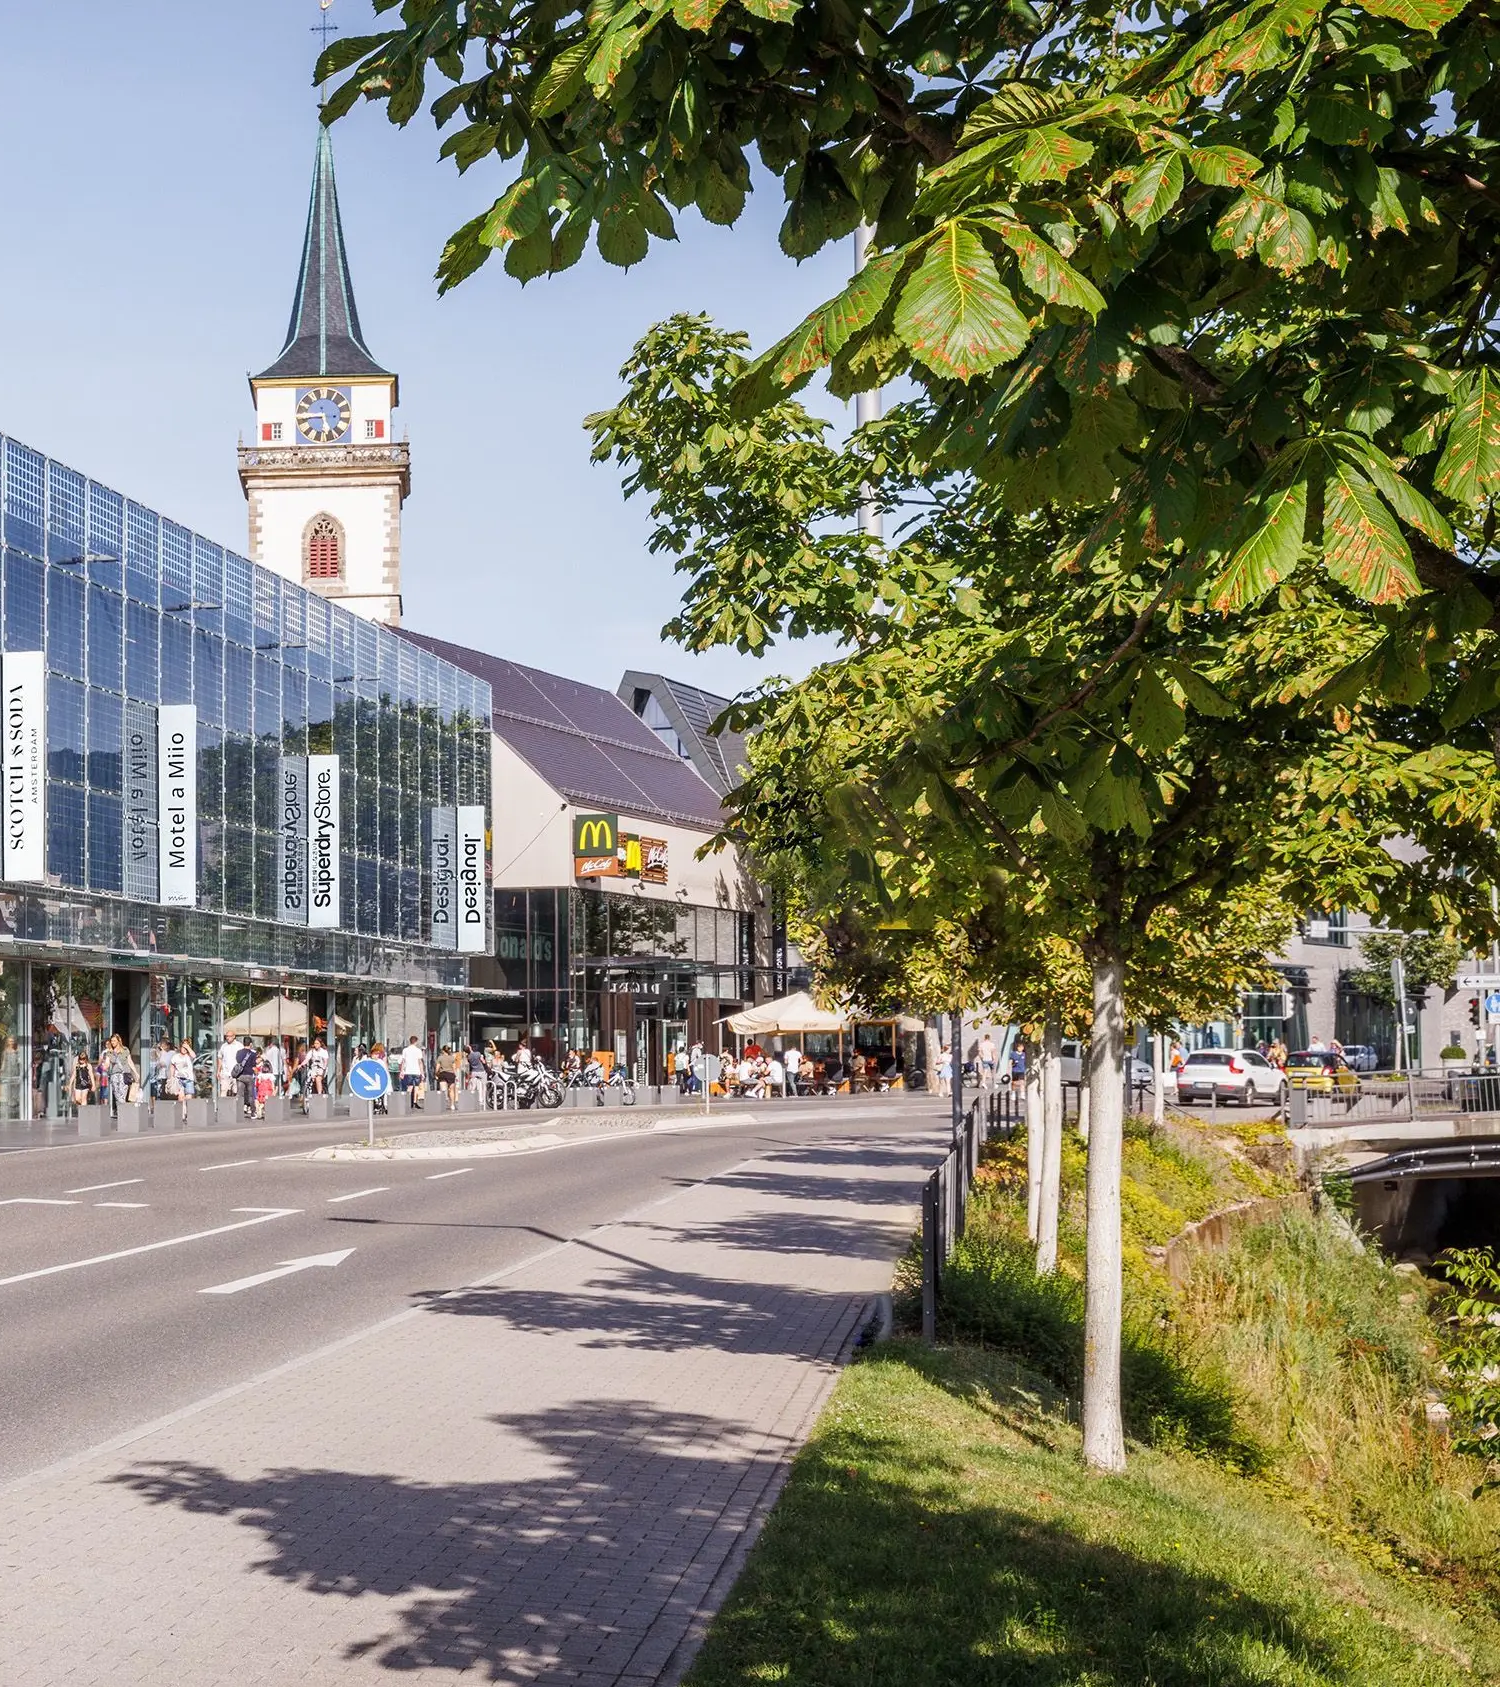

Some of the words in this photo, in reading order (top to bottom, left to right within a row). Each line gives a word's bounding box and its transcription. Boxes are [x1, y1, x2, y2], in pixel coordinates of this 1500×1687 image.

[9, 684, 24, 741] SODA
[167, 732, 185, 778] Miio
[10, 766, 24, 850] SCOTCH
[172, 787, 185, 799] a
[168, 807, 186, 868] Motel
[314, 768, 336, 908] SuperdryStore.
